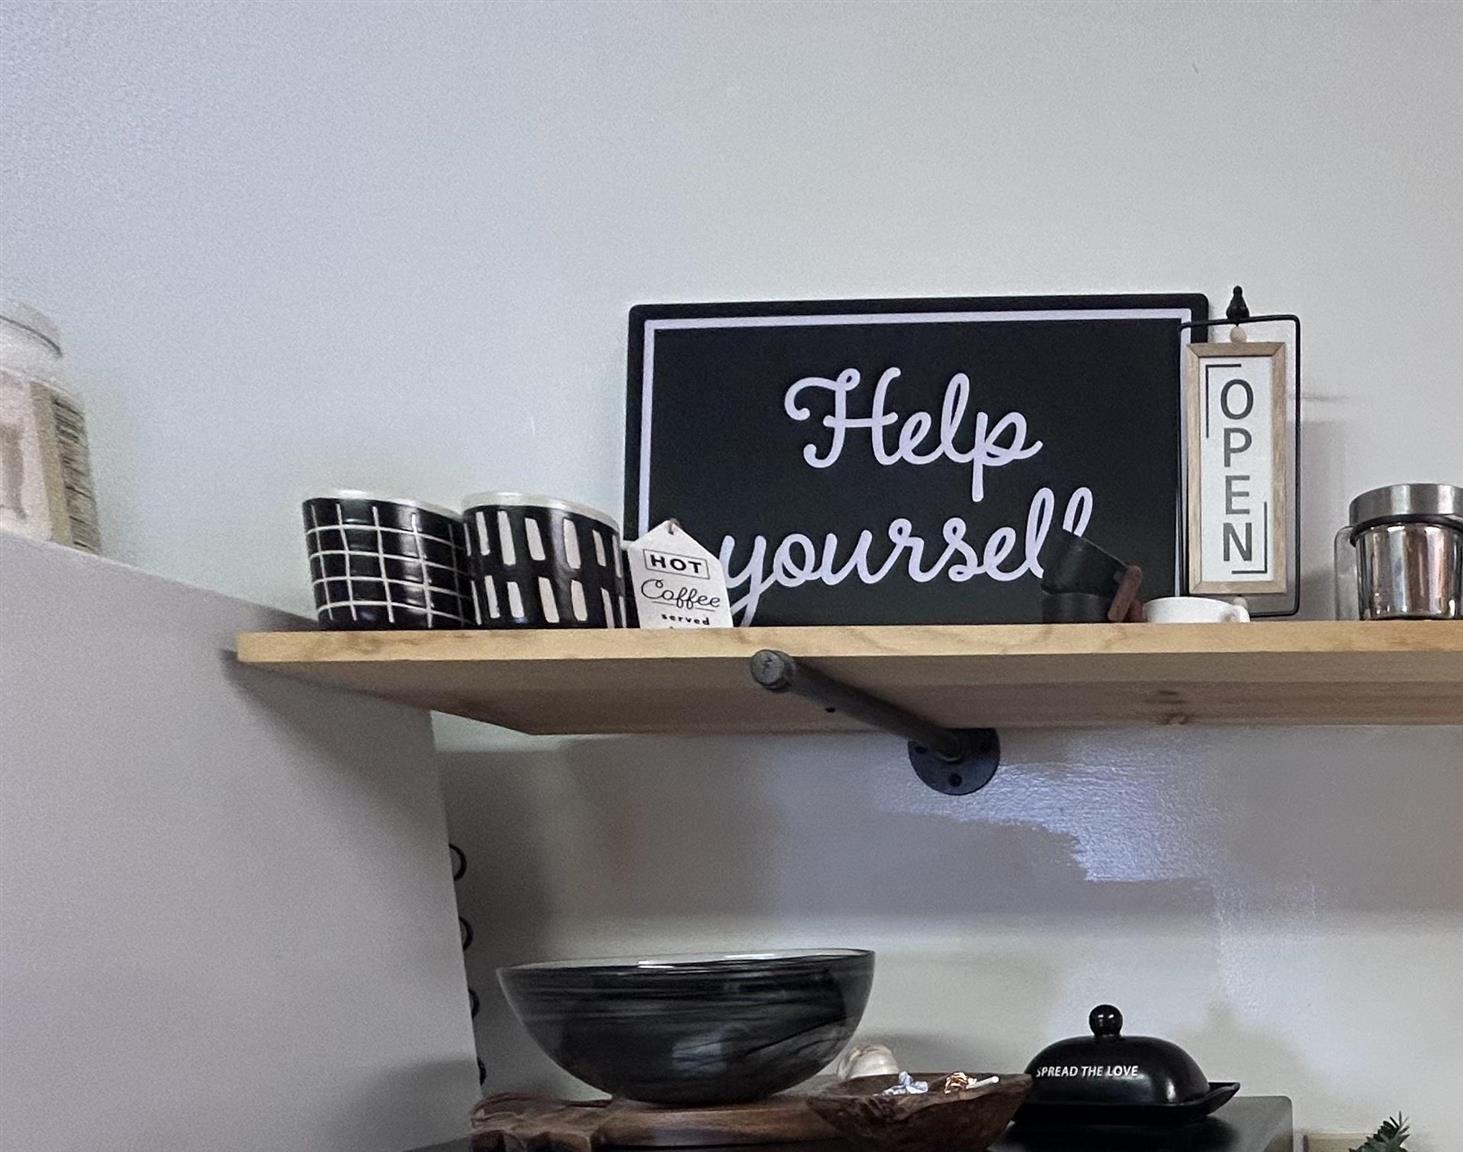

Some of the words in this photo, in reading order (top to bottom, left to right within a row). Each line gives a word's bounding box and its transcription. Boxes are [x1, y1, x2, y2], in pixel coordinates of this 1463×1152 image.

[784, 367, 1043, 502] Help
[1219, 378, 1255, 563] OPEN
[649, 553, 702, 575] HOT
[640, 578, 721, 611] Coffee
[661, 613, 711, 626] served
[1036, 1065, 1079, 1078] SPREAD
[1081, 1065, 1103, 1078] THE
[1107, 1064, 1139, 1078] LOVE
